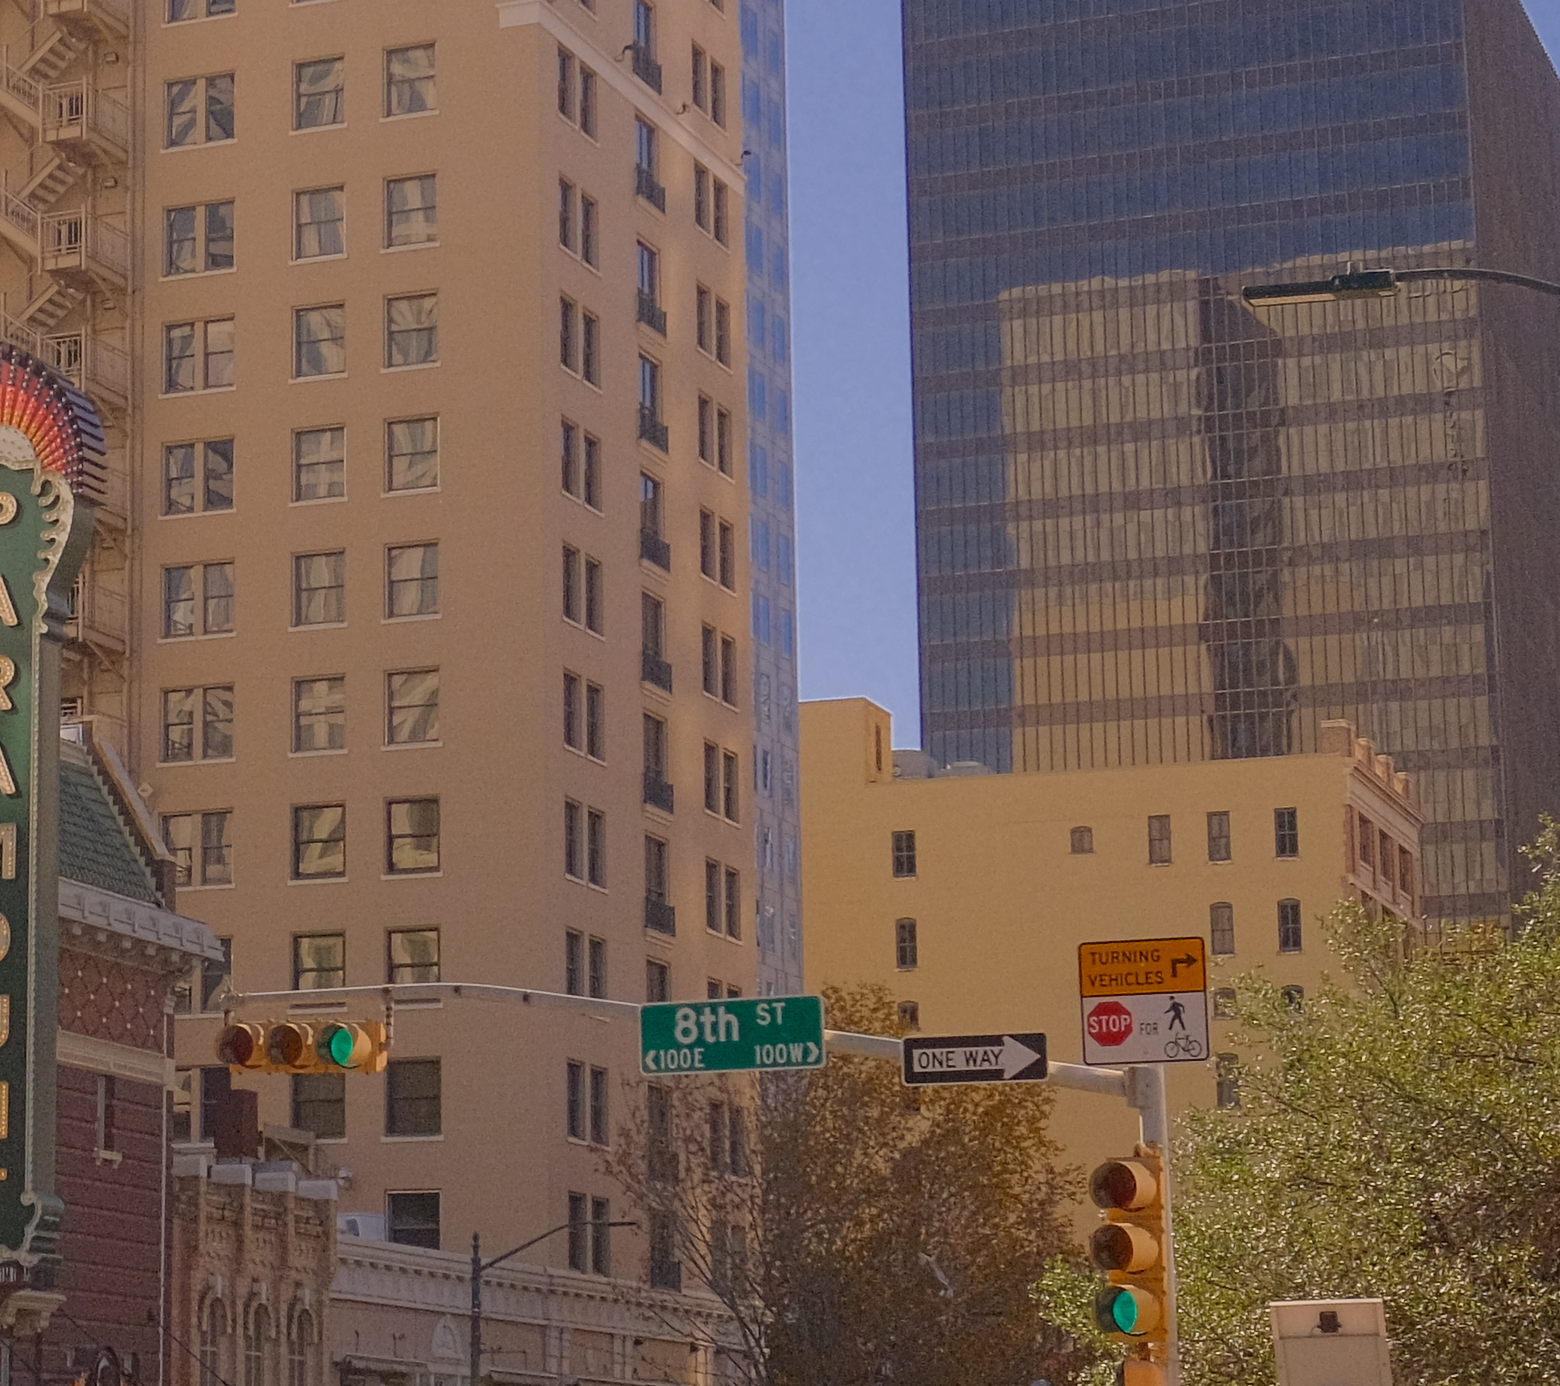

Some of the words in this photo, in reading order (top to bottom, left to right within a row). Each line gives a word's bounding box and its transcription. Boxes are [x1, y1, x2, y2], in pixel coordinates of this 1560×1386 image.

[1089, 949, 1161, 965] TURNING
[1088, 971, 1165, 987] VEHICLES
[674, 1007, 740, 1044] 8th
[756, 1002, 786, 1026] ST
[1088, 1015, 1130, 1033] STOP
[1139, 1022, 1159, 1035] FOR
[659, 1048, 705, 1070] 100E
[754, 1043, 804, 1066] 100W
[917, 1050, 956, 1070] ONE
[963, 1048, 1004, 1067] WAY
